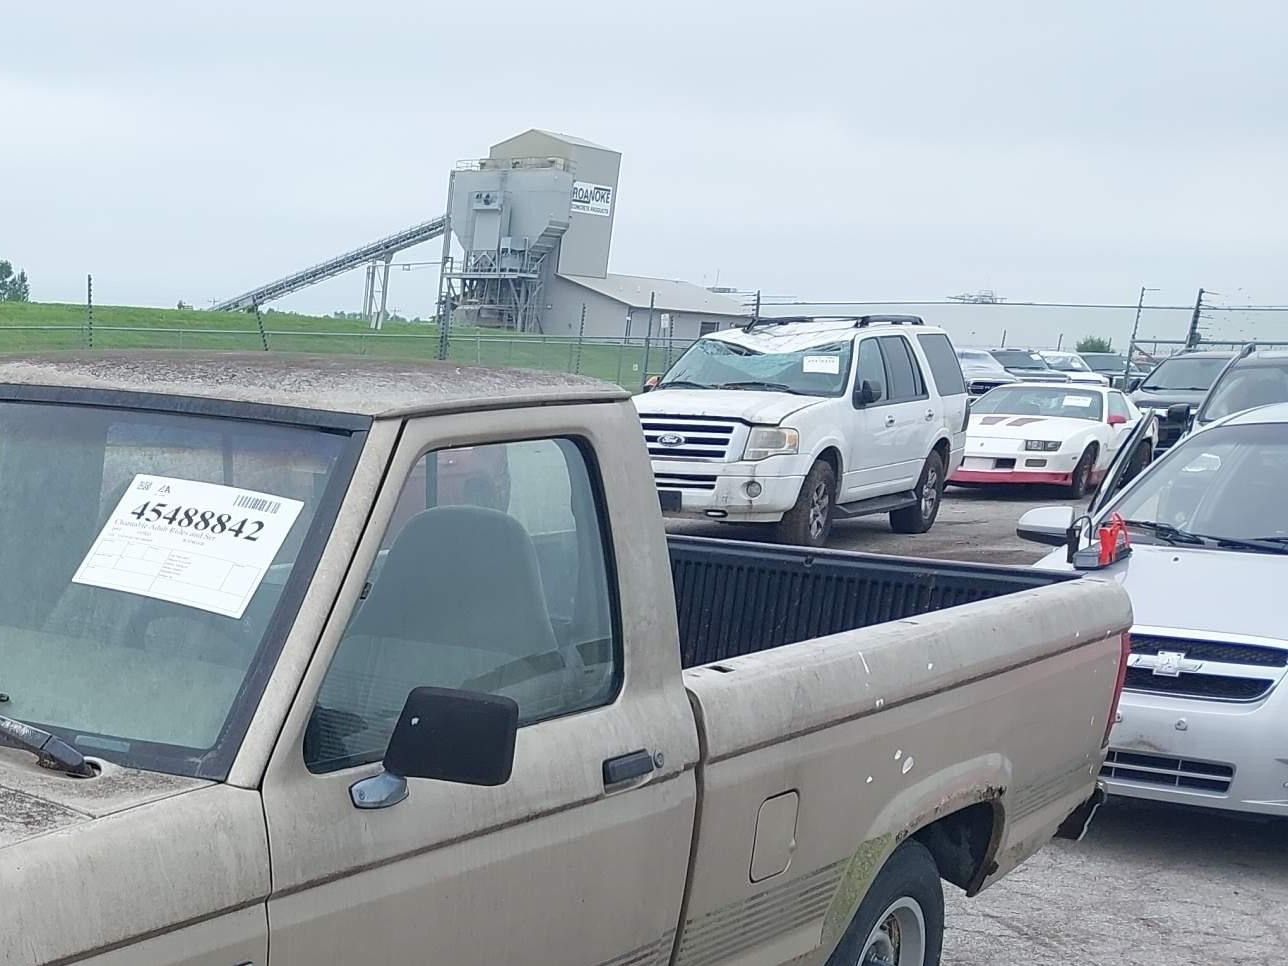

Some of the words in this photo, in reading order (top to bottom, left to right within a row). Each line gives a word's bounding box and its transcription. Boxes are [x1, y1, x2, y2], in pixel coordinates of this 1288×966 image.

[573, 187, 611, 204] ROANOKE
[131, 501, 265, 542] 45488842
[189, 530, 203, 539] and
